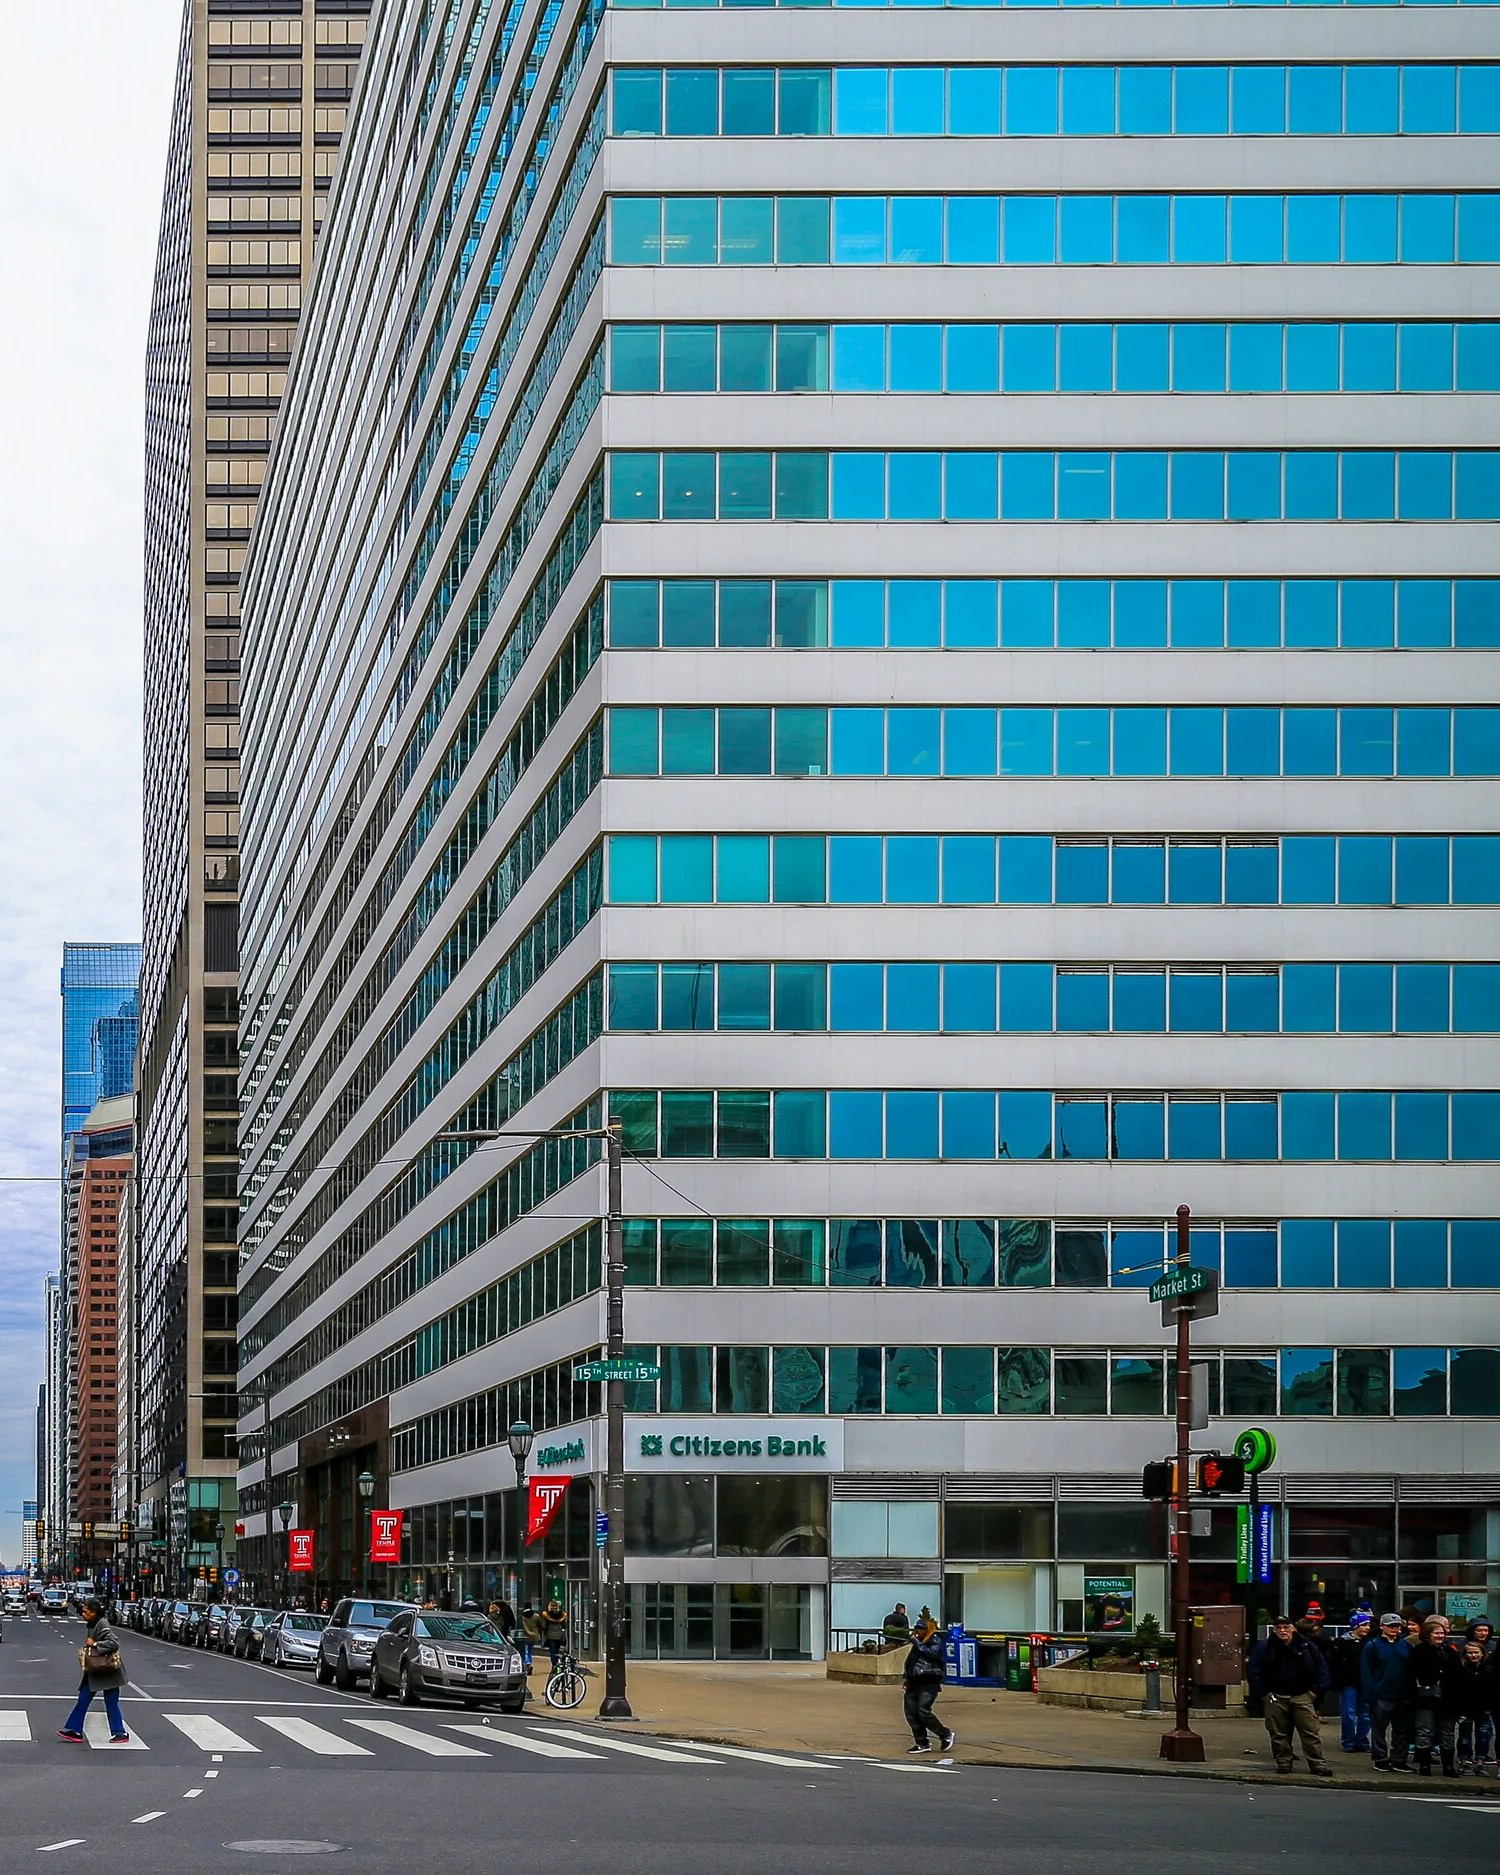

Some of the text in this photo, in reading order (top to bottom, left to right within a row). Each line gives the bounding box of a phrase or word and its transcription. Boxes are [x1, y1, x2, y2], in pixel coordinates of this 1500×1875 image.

[1153, 1277, 1187, 1299] Market
[1191, 1272, 1201, 1289] St
[579, 1367, 658, 1379] 15TH STREET 15TH
[670, 1434, 826, 1456] Citizens Bank
[377, 1517, 397, 1540] T
